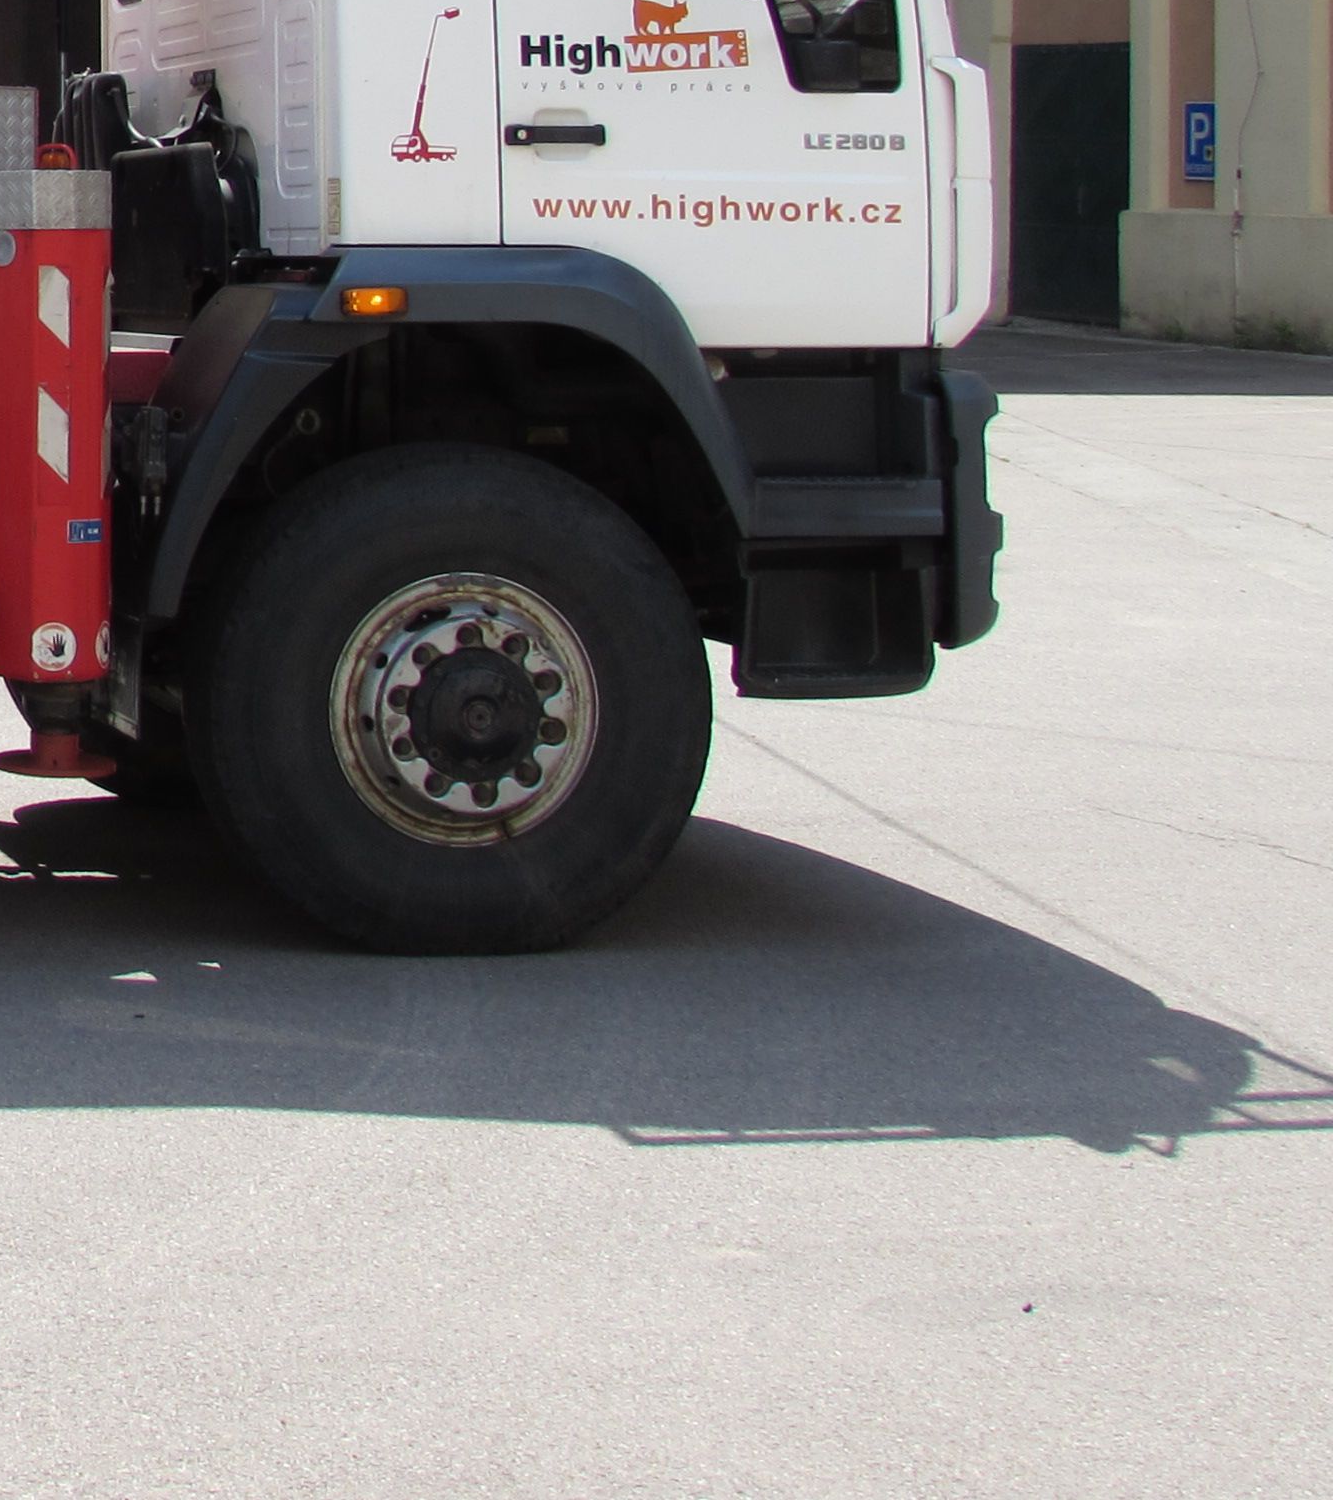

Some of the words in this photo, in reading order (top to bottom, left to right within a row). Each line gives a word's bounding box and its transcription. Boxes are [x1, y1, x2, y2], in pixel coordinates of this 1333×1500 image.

[670, 80, 751, 93] práce
[1190, 112, 1209, 155] P
[533, 194, 903, 228] www.highwork.cz
